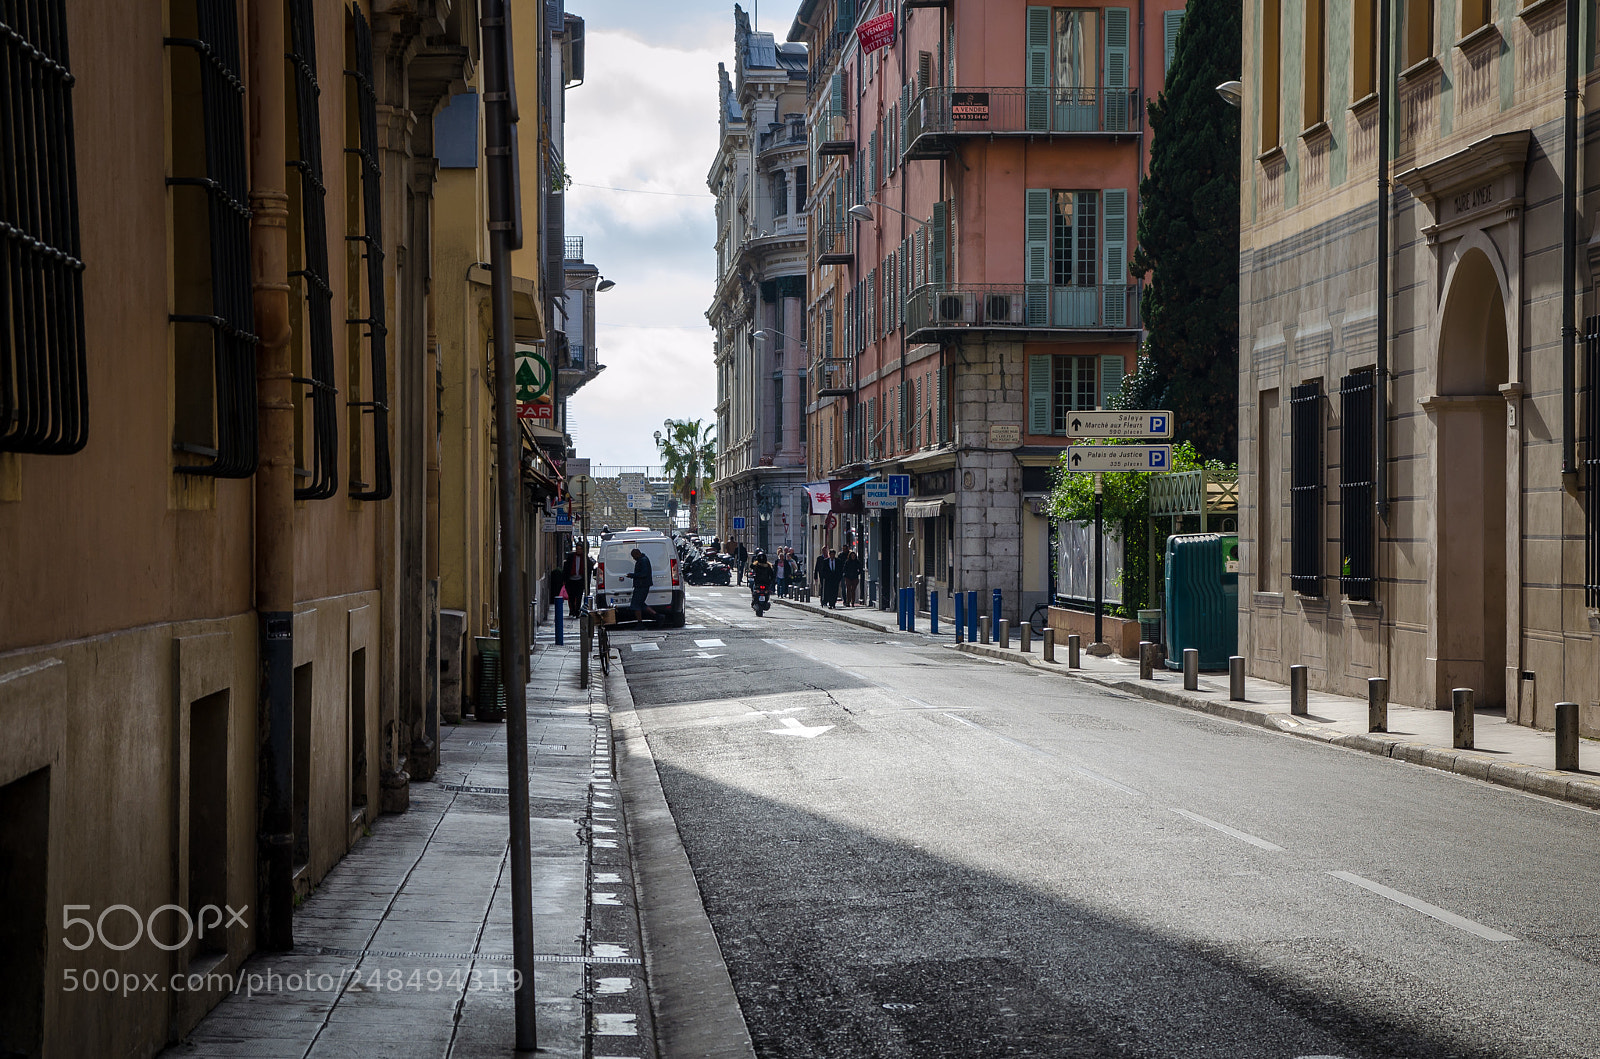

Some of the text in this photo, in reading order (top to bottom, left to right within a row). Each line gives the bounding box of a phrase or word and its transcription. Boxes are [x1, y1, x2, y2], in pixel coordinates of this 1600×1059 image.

[865, 20, 892, 37] VENDRE
[516, 406, 551, 417] PAR
[1118, 414, 1143, 422] Saleya
